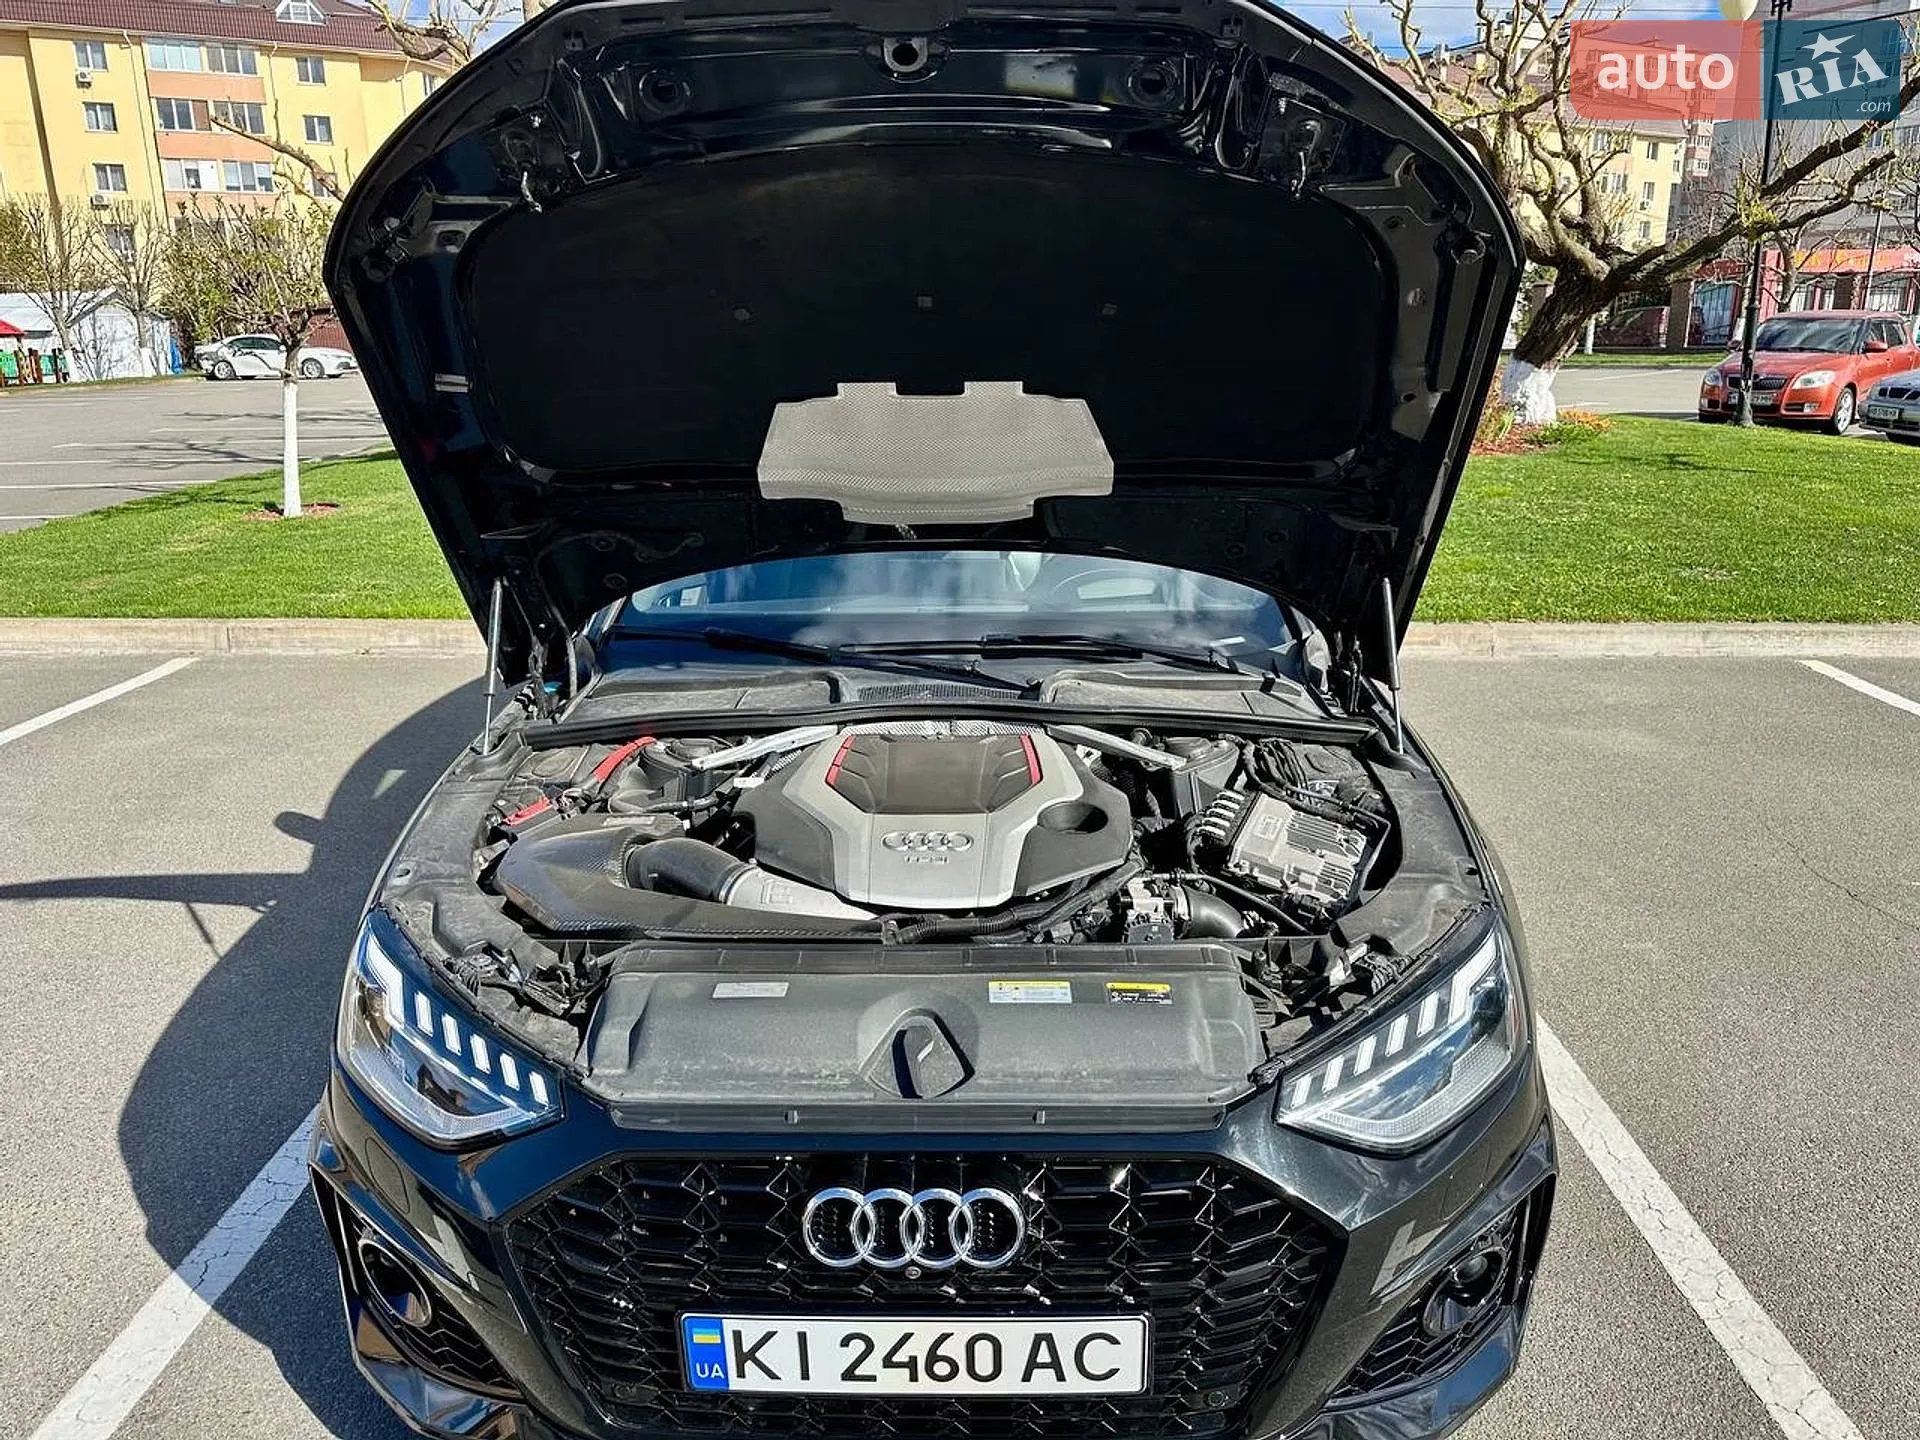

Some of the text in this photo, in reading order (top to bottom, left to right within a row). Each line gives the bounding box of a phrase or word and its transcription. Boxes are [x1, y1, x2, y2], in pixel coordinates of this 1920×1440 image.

[695, 1362, 725, 1379] UA
[731, 1329, 1122, 1383] KI 2460 AC
